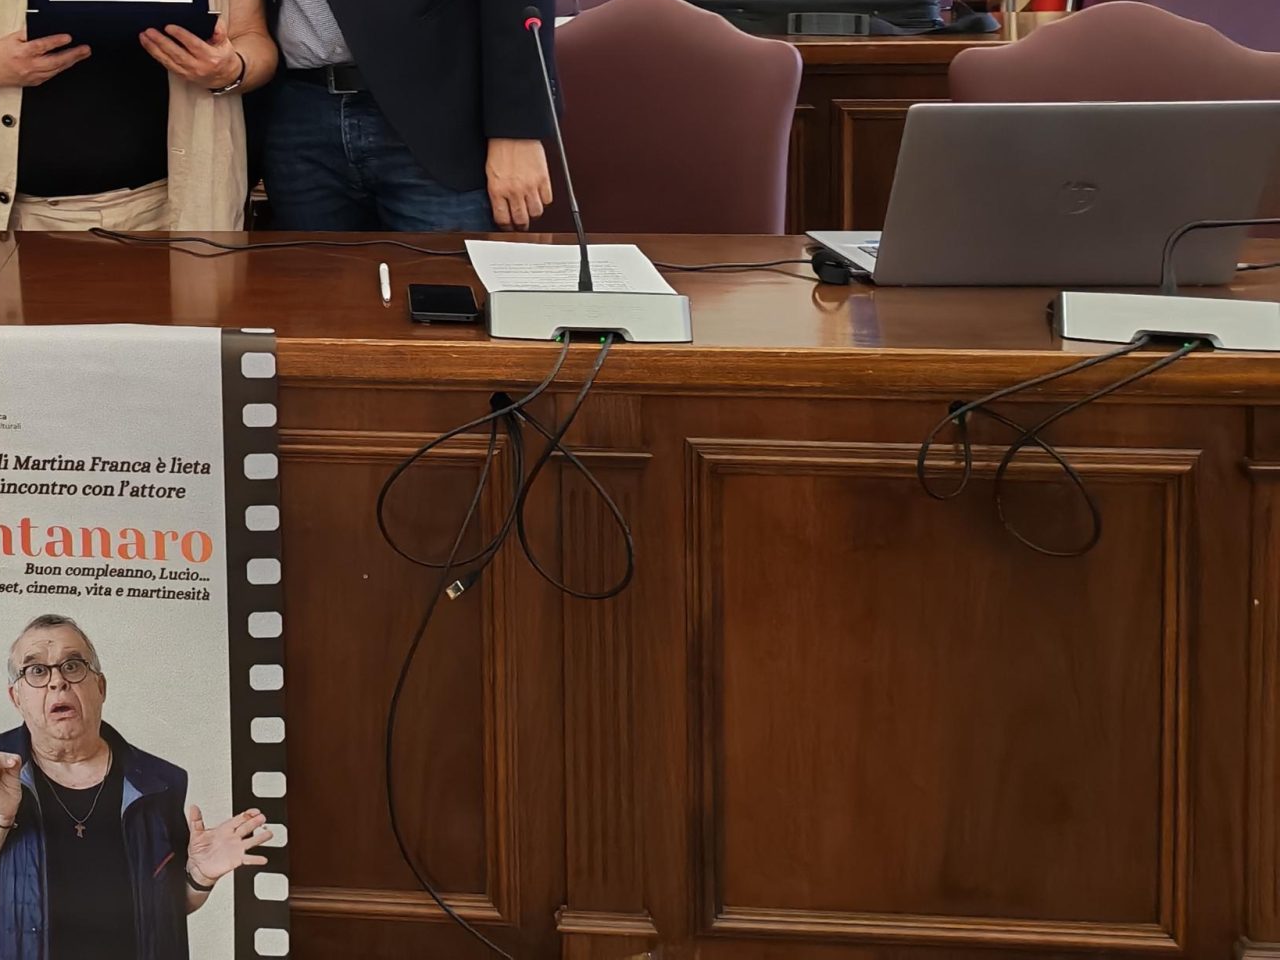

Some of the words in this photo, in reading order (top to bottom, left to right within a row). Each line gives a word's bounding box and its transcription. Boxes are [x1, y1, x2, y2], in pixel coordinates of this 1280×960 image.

[13, 454, 85, 472] Martina
[89, 456, 151, 473] Franca
[156, 457, 166, 474] è
[169, 457, 212, 475] lieta
[82, 483, 115, 497] con
[117, 480, 187, 499] l’attore
[24, 562, 62, 576] Buon
[65, 564, 156, 581] compleanno,
[158, 567, 211, 582] Lucio...
[26, 581, 81, 597] cinema,
[85, 583, 112, 597] vita
[115, 587, 124, 597] e
[126, 586, 211, 601] martinesità
